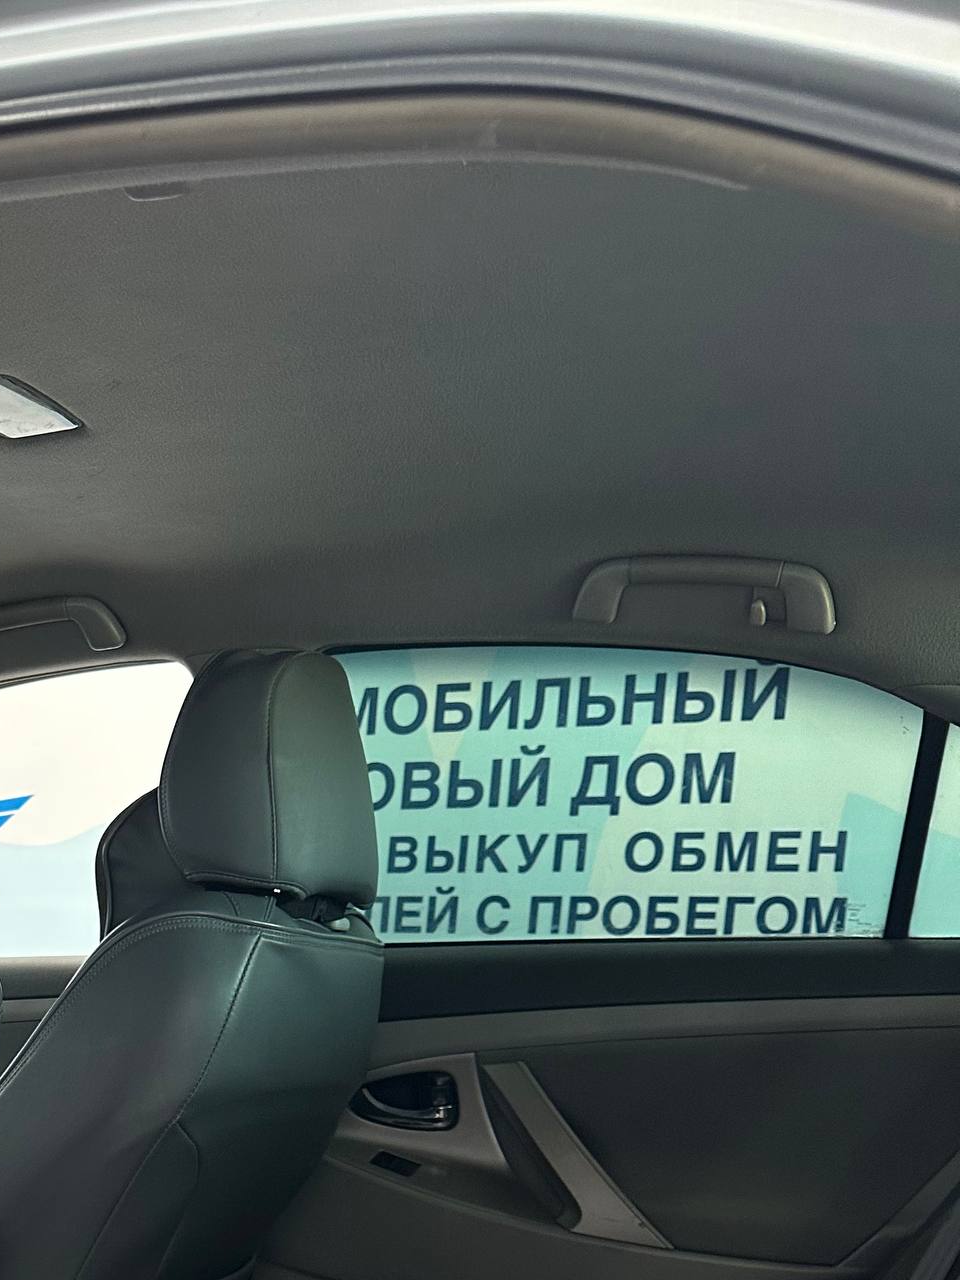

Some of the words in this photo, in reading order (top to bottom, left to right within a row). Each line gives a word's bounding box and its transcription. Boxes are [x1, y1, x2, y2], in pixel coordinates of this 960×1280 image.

[569, 752, 736, 817] ДОМ
[387, 833, 588, 874] ВЫКУП
[624, 830, 848, 873] ОБМЕН
[476, 896, 511, 935] С
[527, 895, 848, 935] ПРОБЕГОМ
